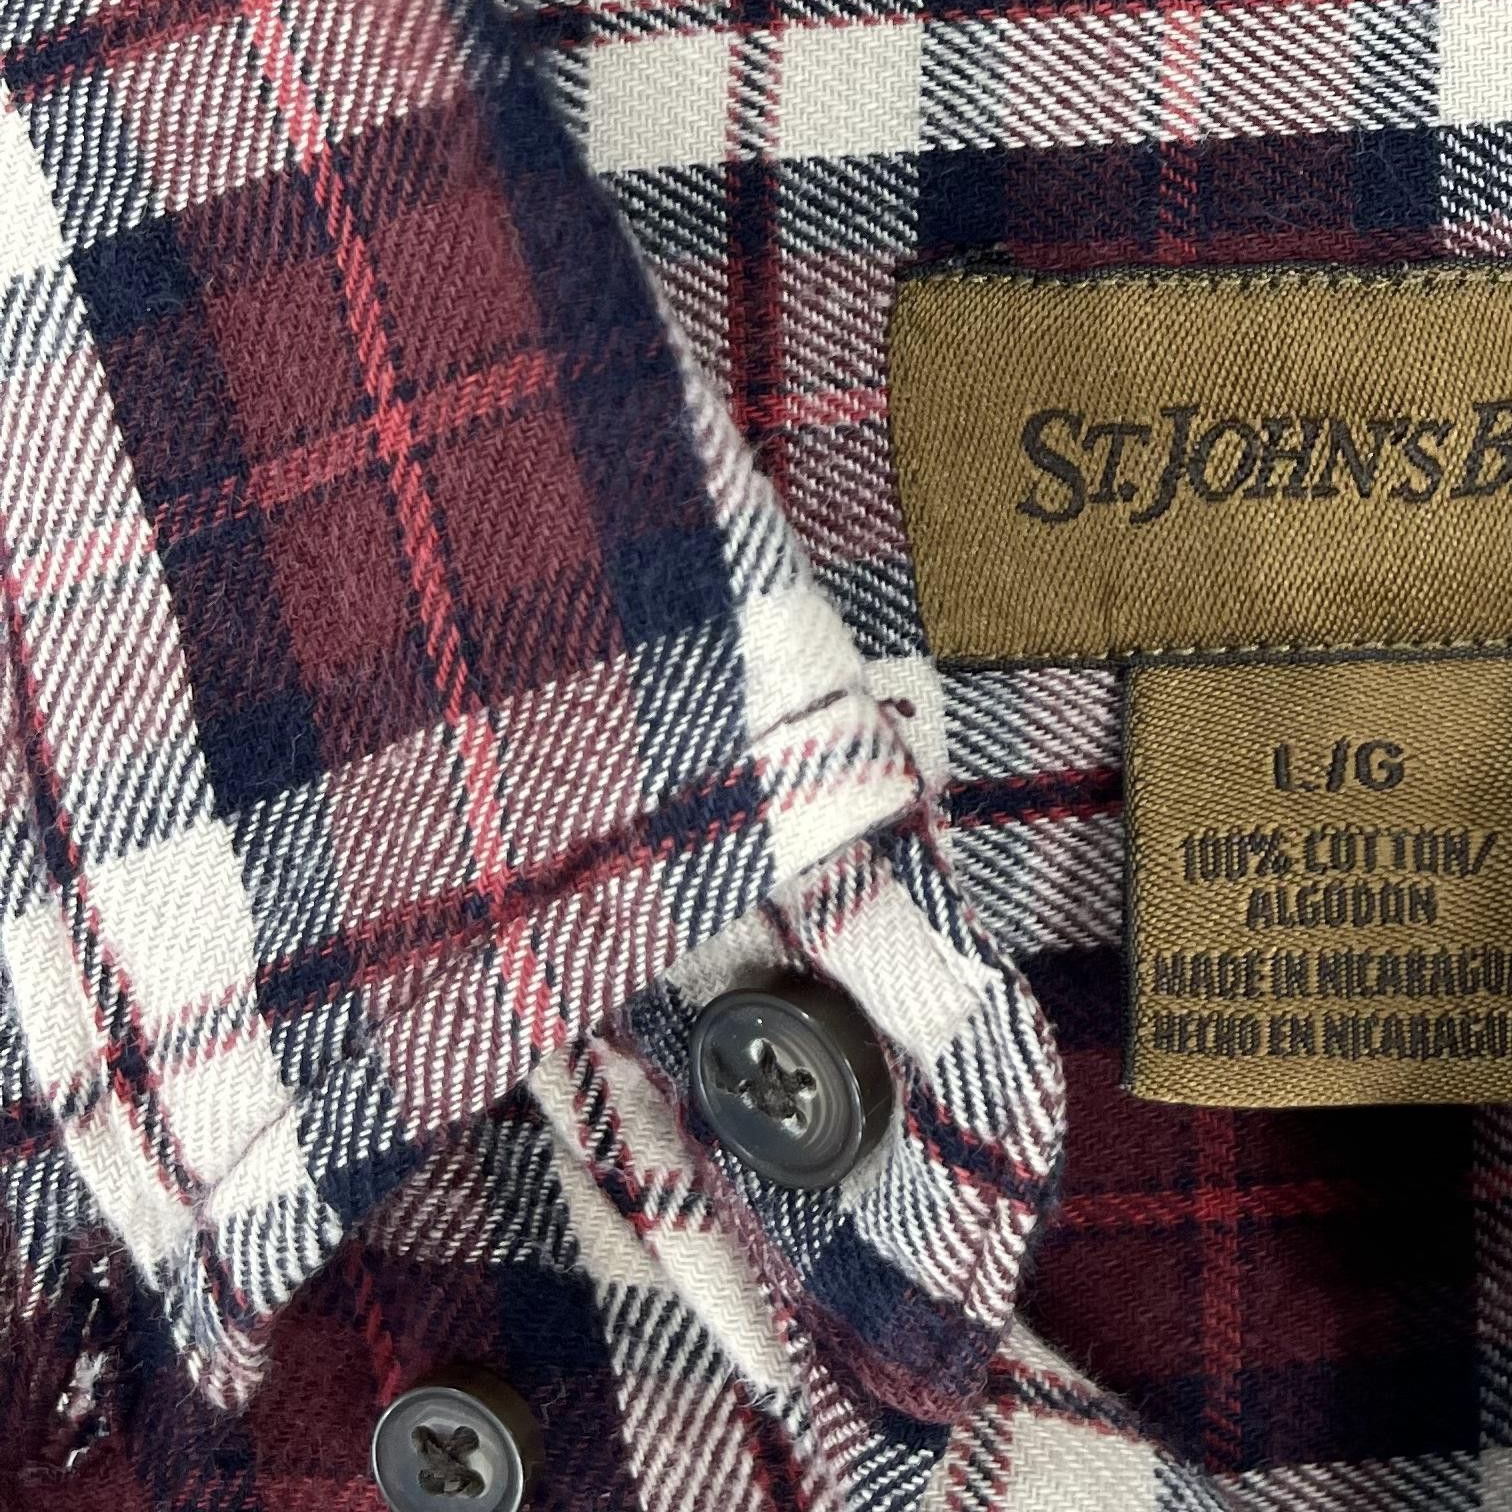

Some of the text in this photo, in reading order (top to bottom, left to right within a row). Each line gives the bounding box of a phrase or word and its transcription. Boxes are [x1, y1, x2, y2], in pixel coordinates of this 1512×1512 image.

[1273, 735, 1405, 792] L/G
[1181, 829, 1291, 884] 100%
[1246, 880, 1439, 930] ALGODON
[1152, 949, 1264, 1000] MADE
[1268, 949, 1308, 1000] IN
[1152, 1010, 1261, 1058] HECHO
[1267, 1011, 1316, 1058] EN
